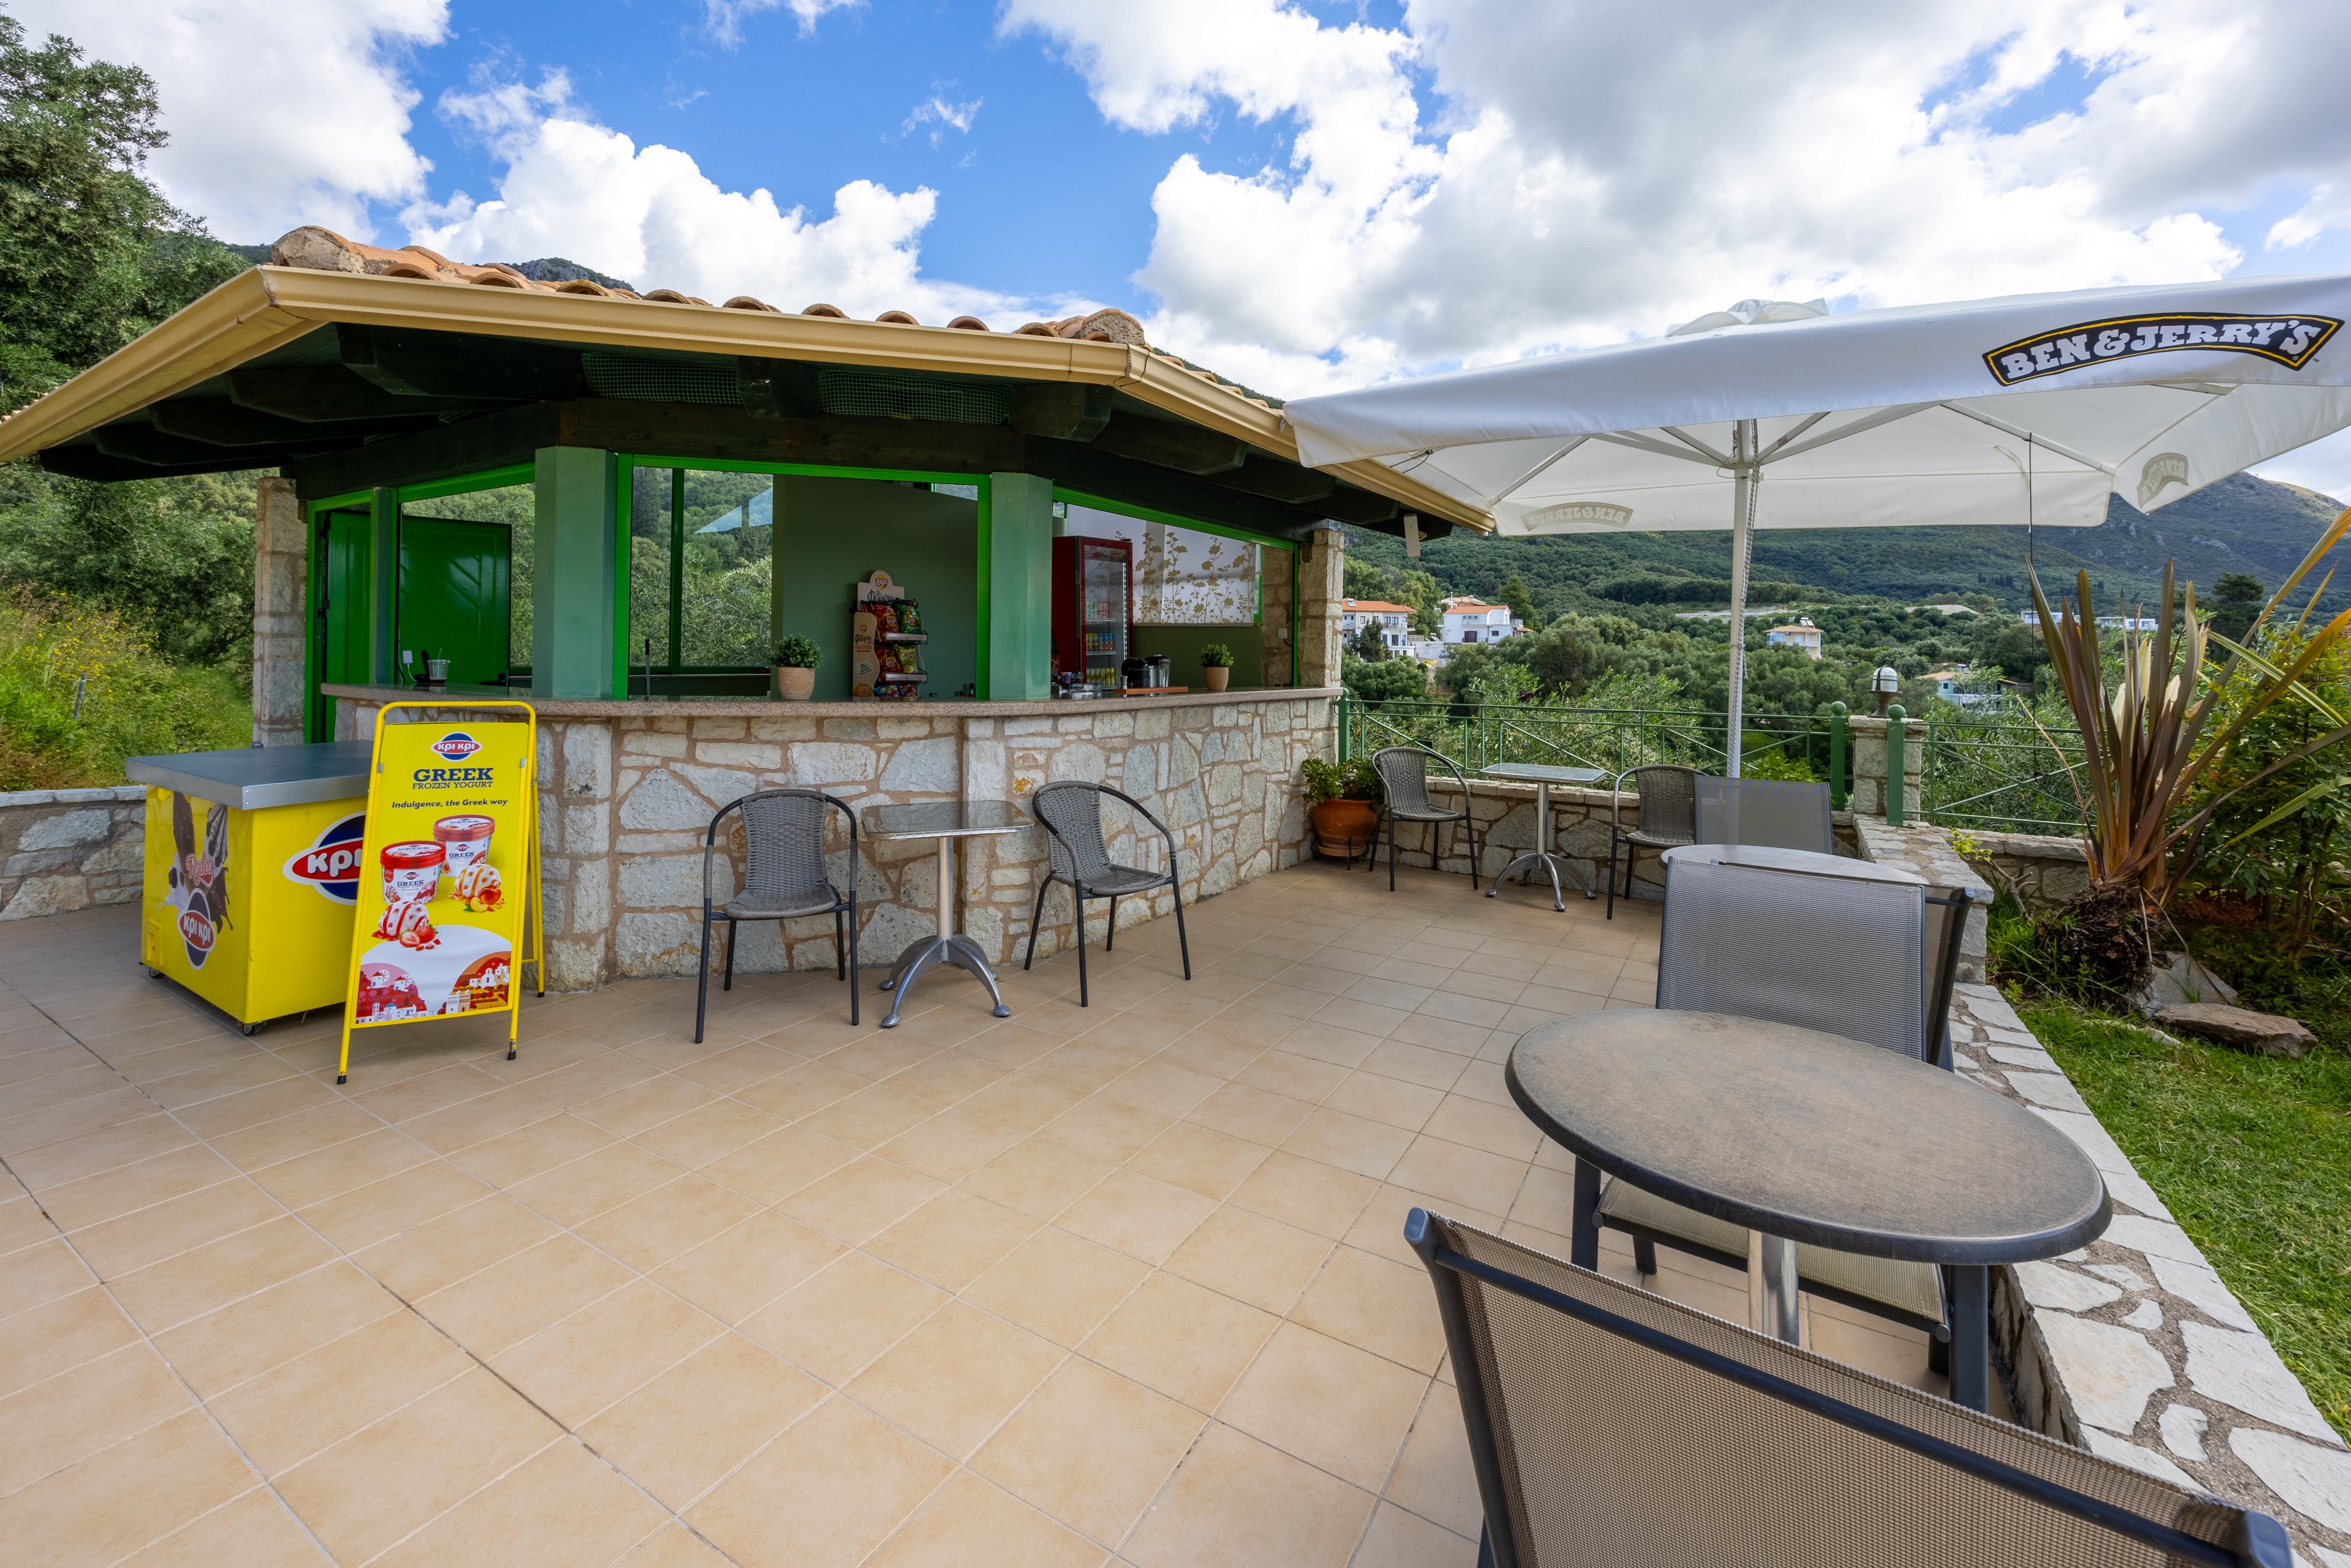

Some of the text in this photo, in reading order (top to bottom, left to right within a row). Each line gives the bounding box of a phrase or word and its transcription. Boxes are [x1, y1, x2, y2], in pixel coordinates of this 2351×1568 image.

[413, 767, 493, 782] GREEK
[392, 800, 443, 809] Indulgence,
[186, 852, 214, 885] Rodeo
